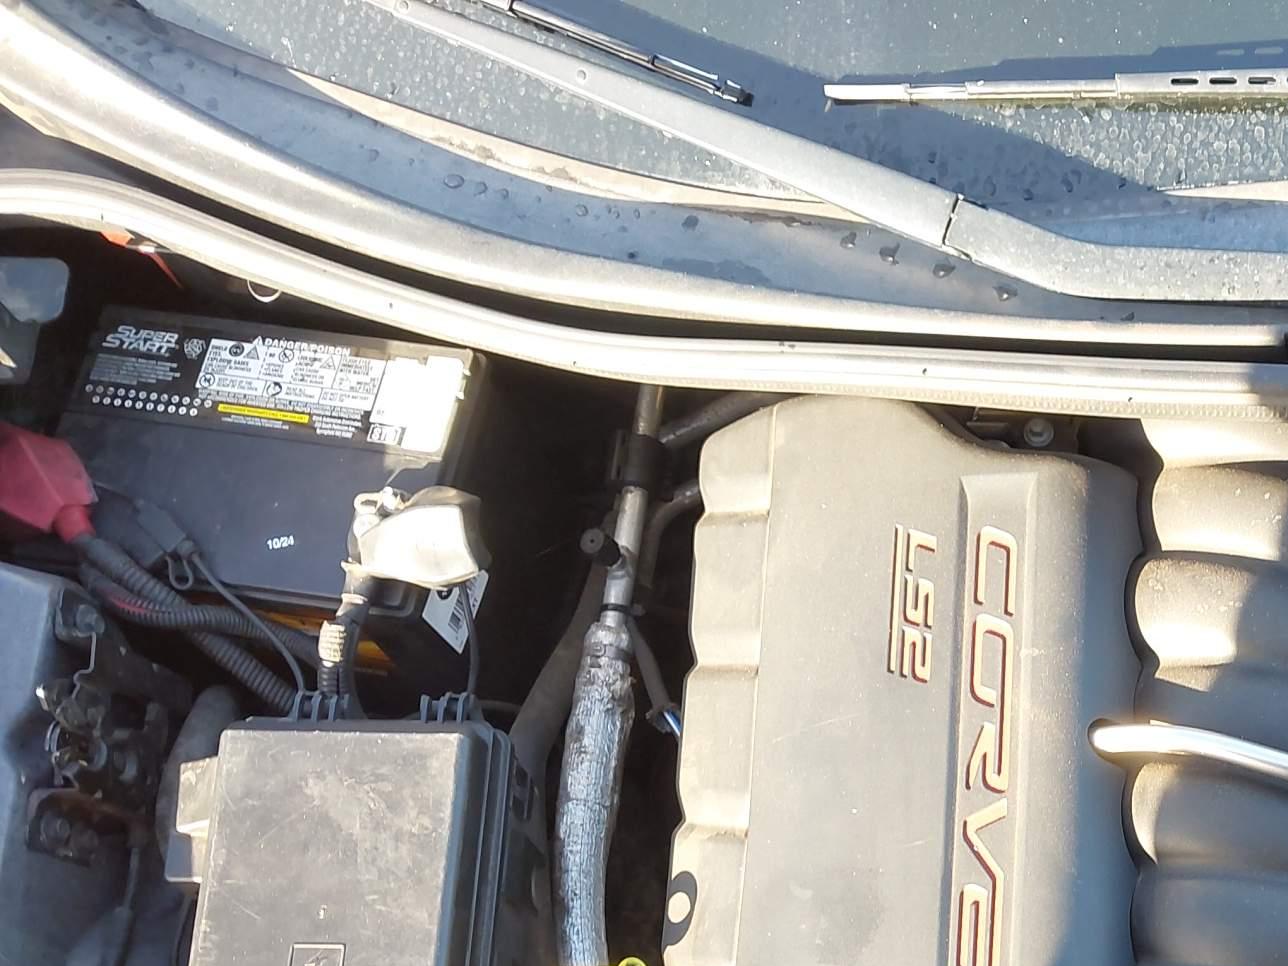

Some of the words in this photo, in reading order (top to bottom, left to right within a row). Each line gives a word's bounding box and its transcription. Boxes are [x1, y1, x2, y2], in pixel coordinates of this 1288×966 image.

[114, 325, 179, 342] SUPER
[102, 333, 175, 355] START
[266, 535, 295, 550] 10/24
[900, 528, 938, 685] LS2
